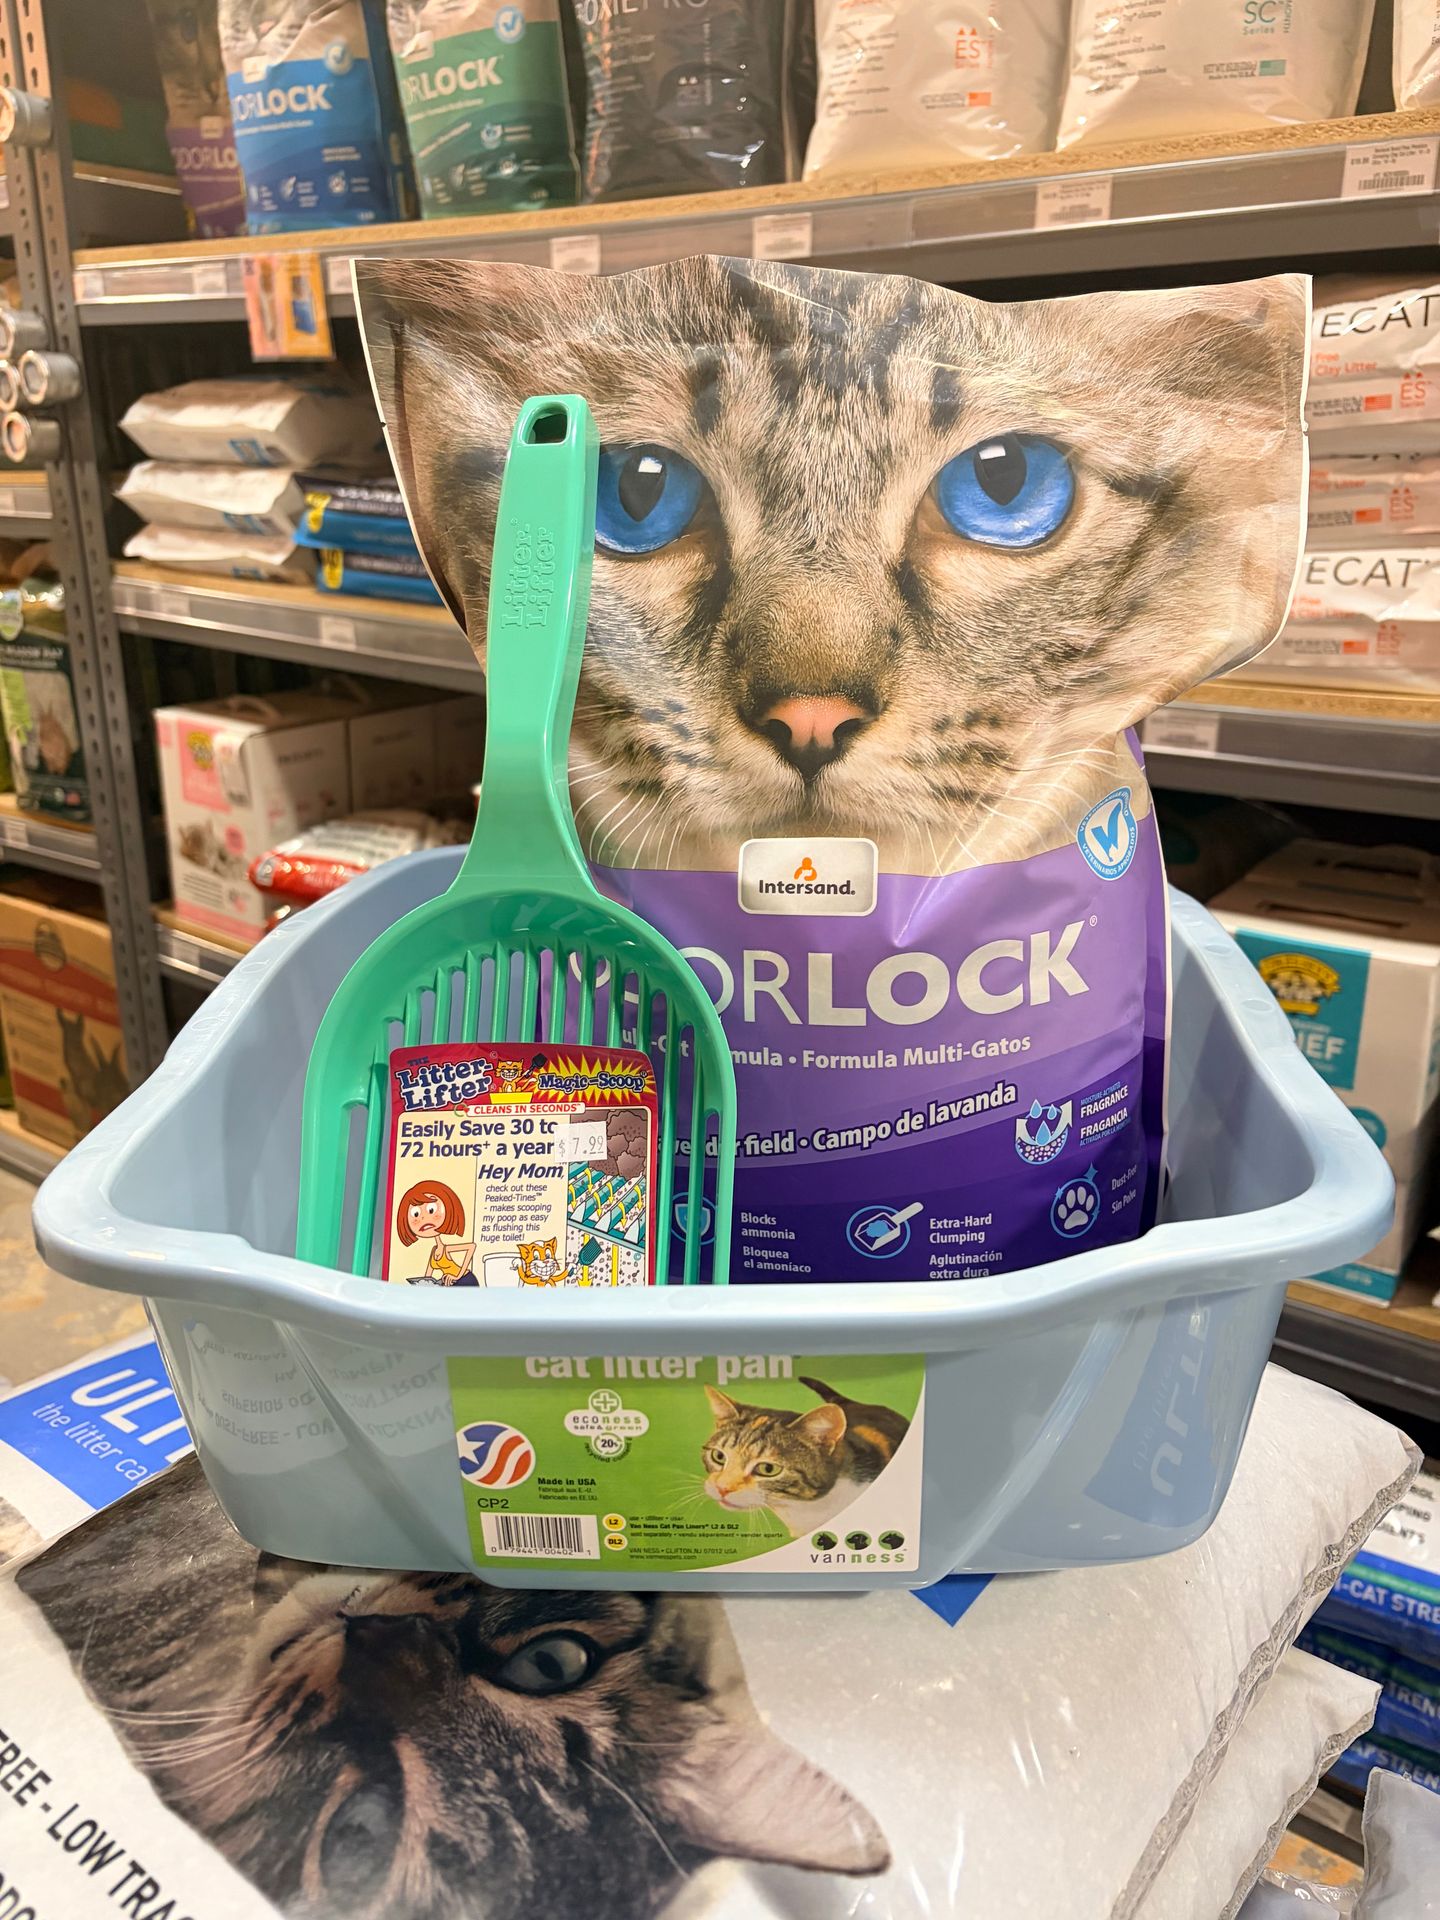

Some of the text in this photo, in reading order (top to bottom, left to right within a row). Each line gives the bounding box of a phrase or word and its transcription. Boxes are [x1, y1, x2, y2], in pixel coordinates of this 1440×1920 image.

[803, 1050, 898, 1069] Formula
[904, 1036, 1031, 1066] Multi-Gatos
[538, 1071, 644, 1094] Magic-Scoop
[402, 1076, 491, 1110] Lifter
[473, 1103, 578, 1115] CLEANS IN SECONDS
[1080, 1085, 1129, 1119] FRAGRANCE
[744, 1081, 1017, 1155] field Campo de lavanda
[1080, 1107, 1128, 1139] FRAGANCIA
[401, 1120, 455, 1140] Easily
[460, 1119, 504, 1136] Save
[510, 1119, 534, 1135] 30
[400, 1141, 424, 1158] 72
[496, 1145, 507, 1155] a
[513, 1142, 554, 1159] year
[478, 1163, 565, 1182] Hey Mom,
[1111, 1165, 1137, 1191] Dust-Free
[486, 1183, 548, 1193] check out these
[489, 1204, 515, 1212] makes
[517, 1204, 552, 1213] scooping
[1111, 1200, 1122, 1214] Sin
[482, 1215, 495, 1223] my
[497, 1214, 517, 1223] poop
[530, 1214, 549, 1223] easy
[740, 1212, 777, 1225] Blocks
[929, 1213, 992, 1229] Extra-Hard
[493, 1223, 526, 1233] flushing
[528, 1223, 540, 1231] this
[741, 1227, 796, 1240] ammonia
[480, 1233, 525, 1243] huge toilet!
[929, 1231, 985, 1245] Clumping
[743, 1245, 789, 1260] Bloquea
[929, 1251, 1003, 1268] Aglutinación
[743, 1259, 812, 1274] el amoníaco
[929, 1267, 990, 1279] extra dura
[525, 1356, 591, 1379] cat
[716, 1355, 793, 1386] pan
[32, 1401, 71, 1428] the
[64, 1421, 123, 1460] litter
[538, 1477, 563, 1485] Made
[577, 1478, 597, 1486] USA
[477, 1497, 509, 1509] CP2
[510, 1547, 538, 1555] 79441
[47, 1803, 126, 1876] LOW
